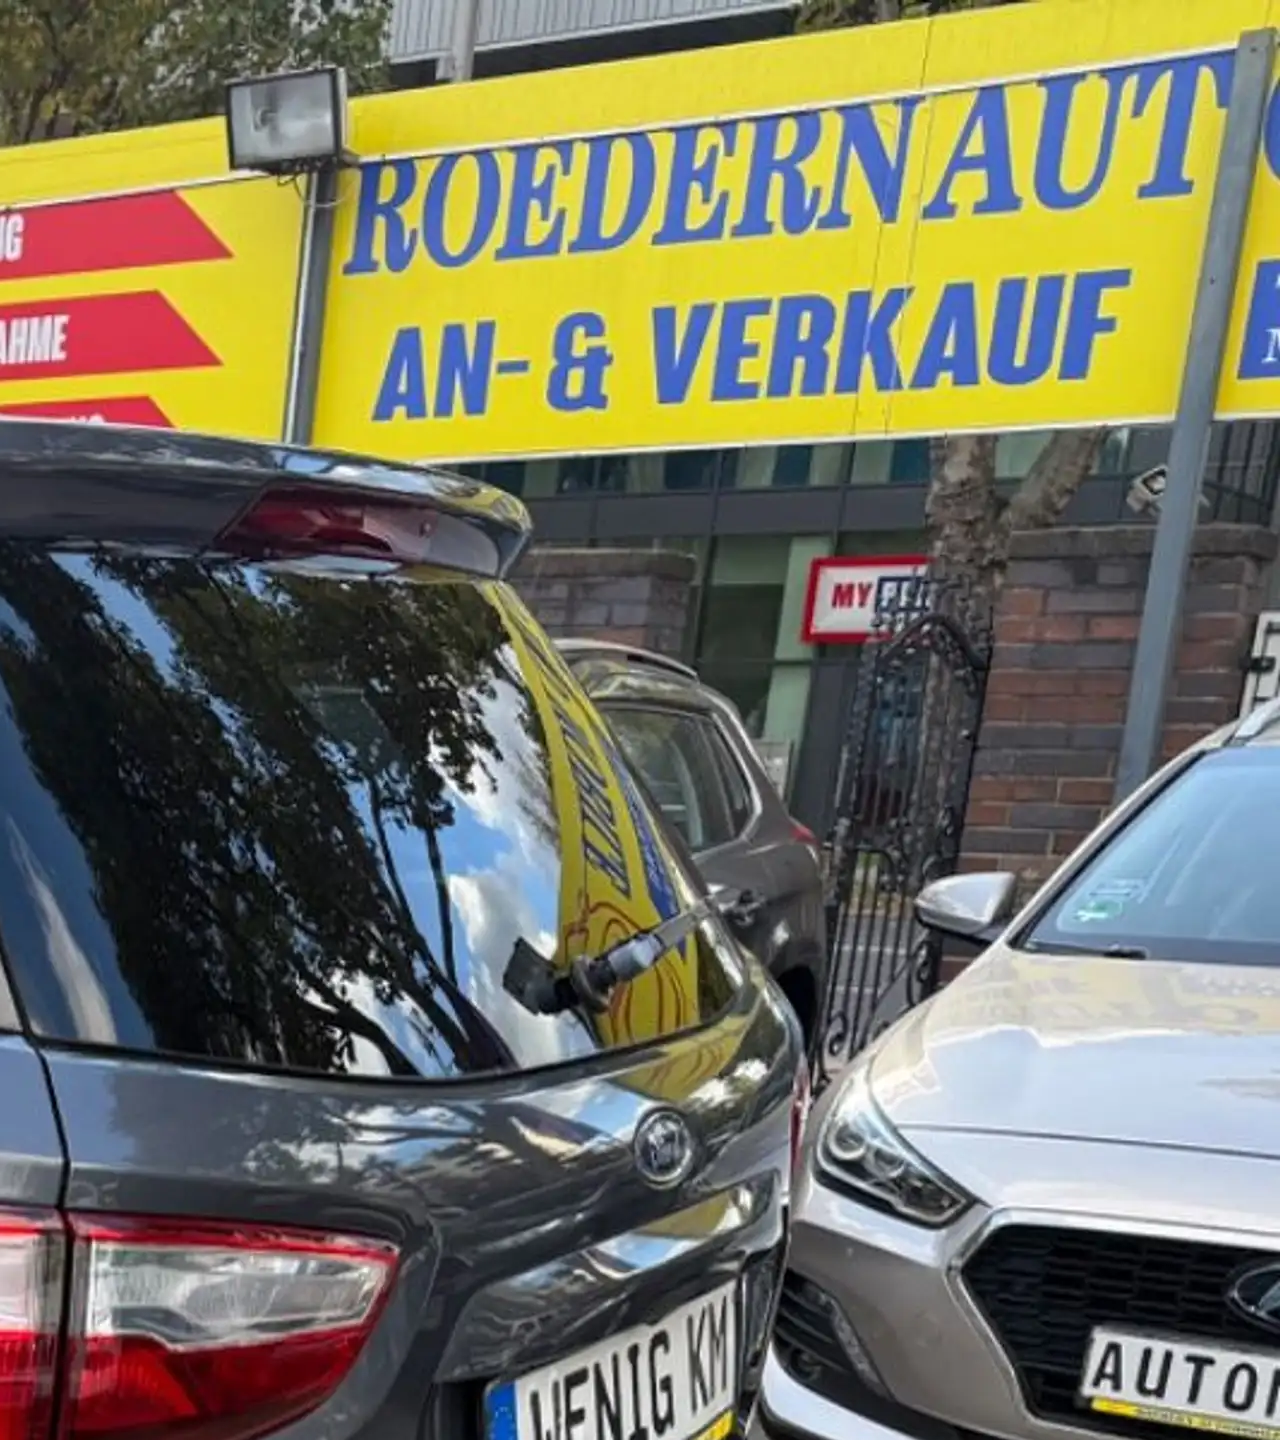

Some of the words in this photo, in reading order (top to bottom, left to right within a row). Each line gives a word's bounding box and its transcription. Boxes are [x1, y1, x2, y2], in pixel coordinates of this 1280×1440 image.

[371, 320, 530, 421] AN-
[546, 312, 613, 412] &
[651, 269, 1132, 404] VERKAUF
[687, 1296, 727, 1416] KM
